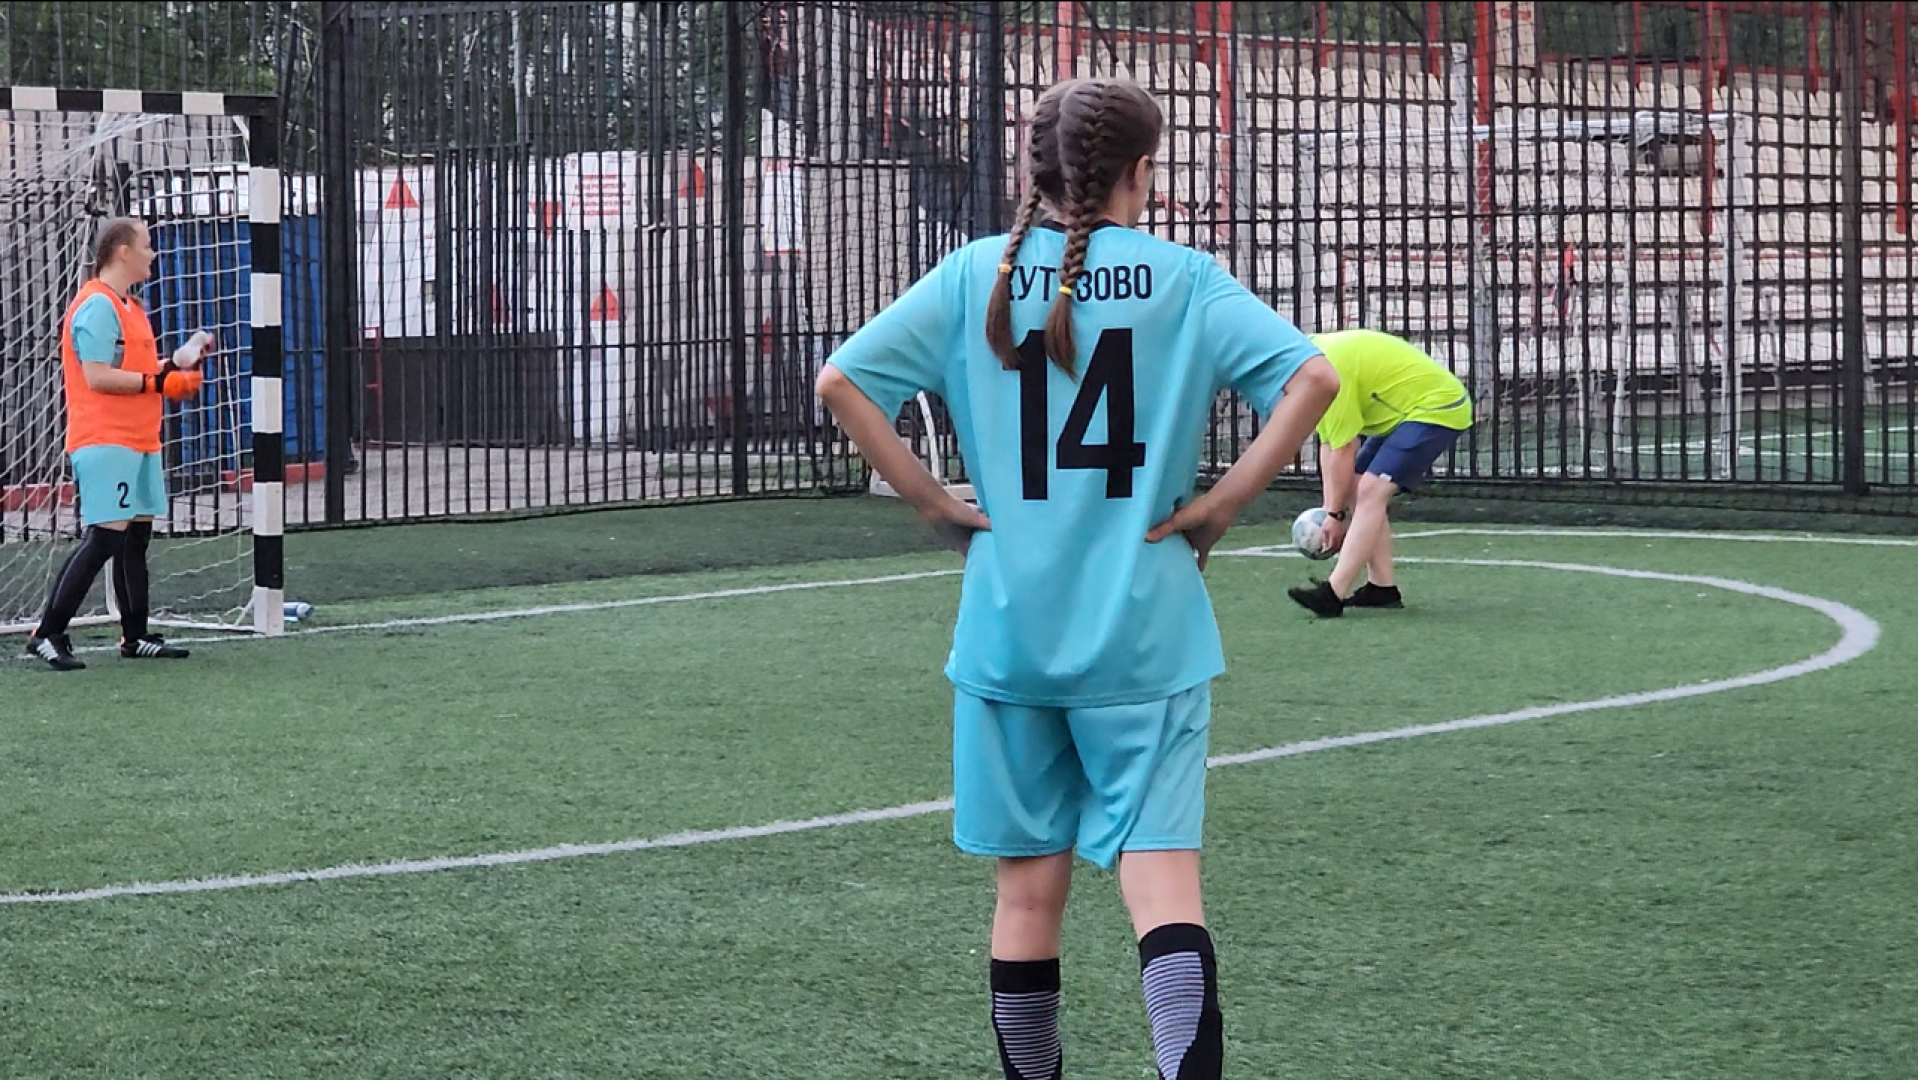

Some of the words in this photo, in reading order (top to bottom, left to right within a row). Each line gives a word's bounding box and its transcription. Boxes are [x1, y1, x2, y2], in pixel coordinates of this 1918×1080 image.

[998, 264, 1153, 302] УТЗОВО
[1002, 328, 1147, 500] 14
[117, 481, 131, 509] 2
